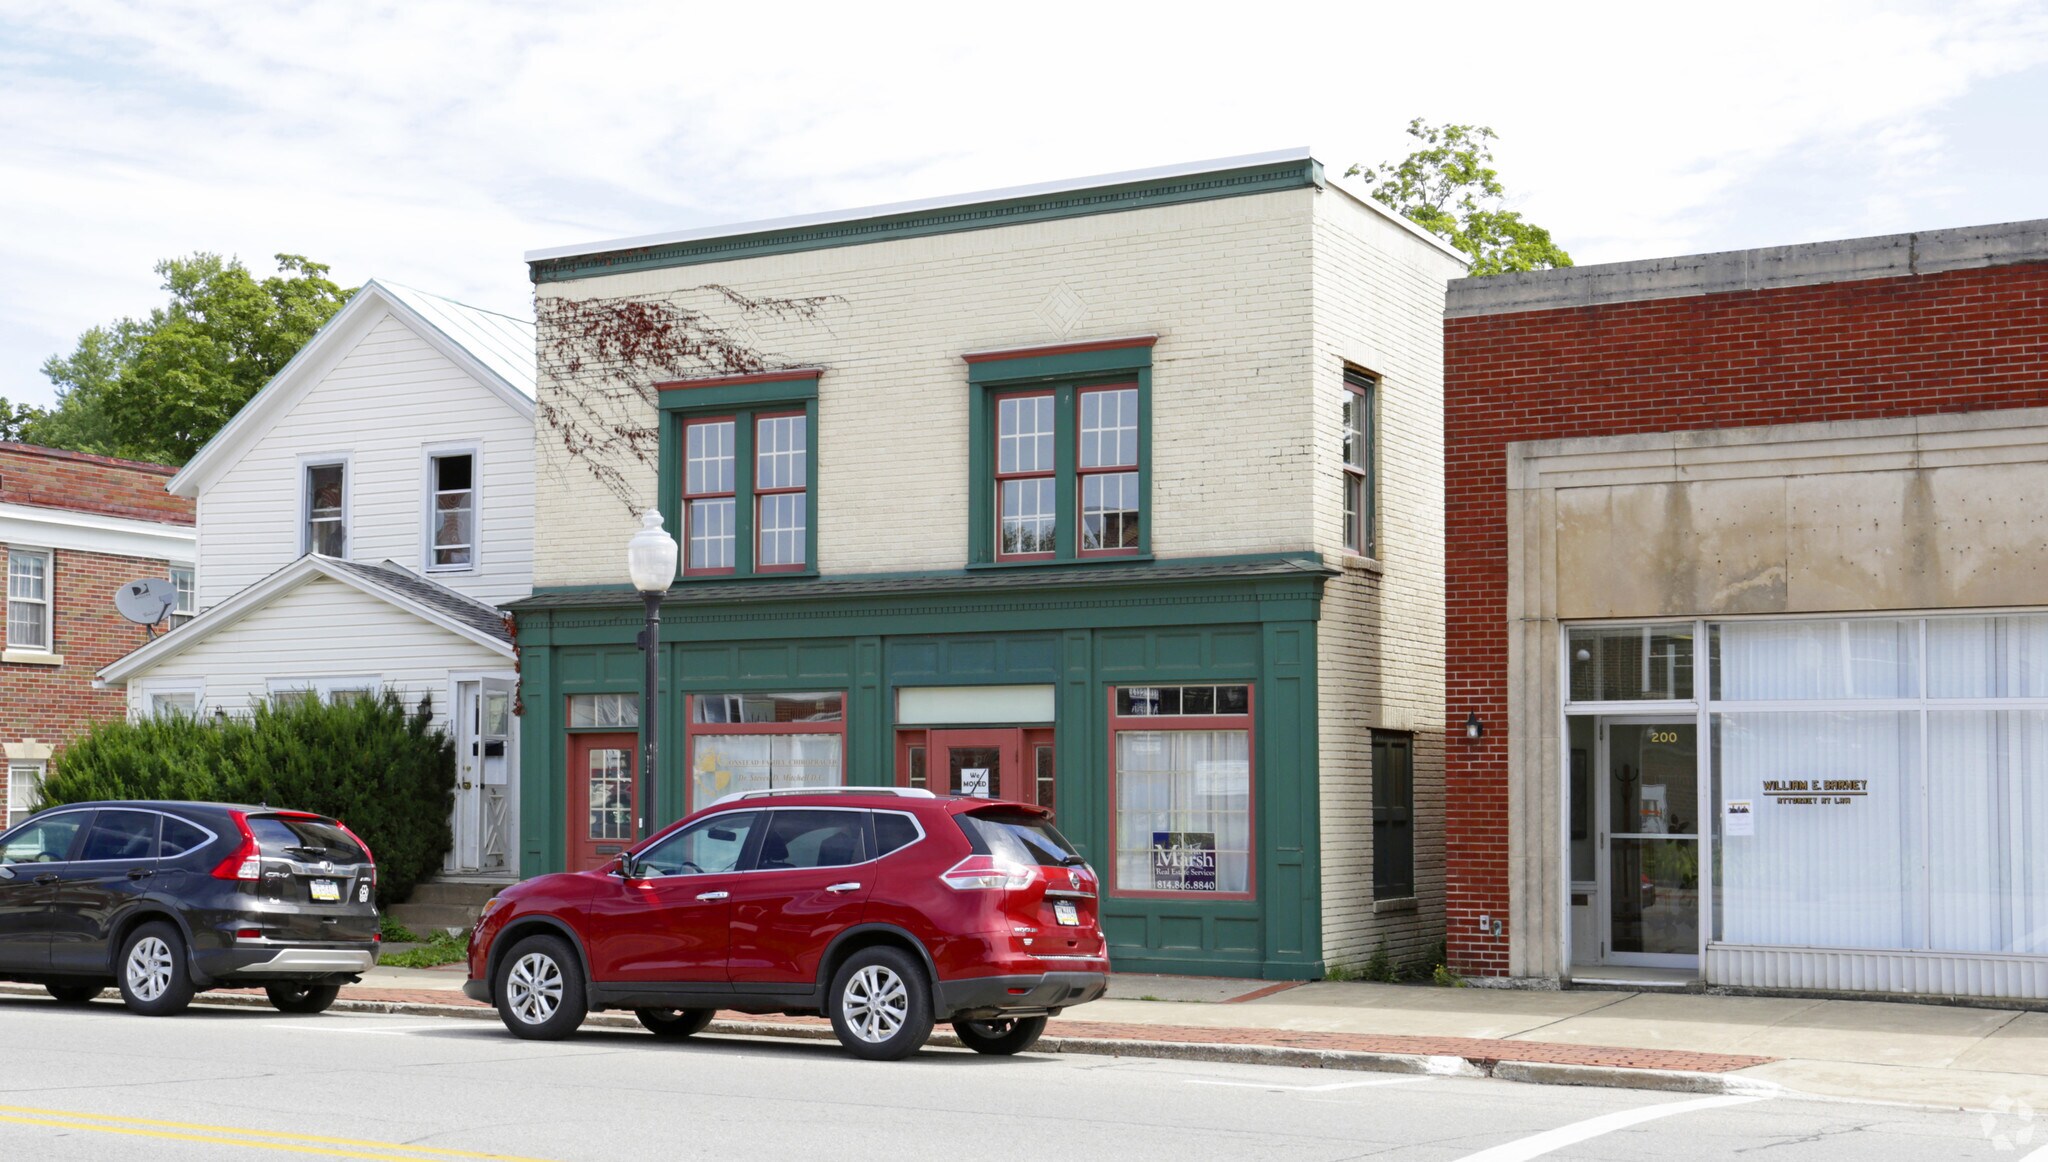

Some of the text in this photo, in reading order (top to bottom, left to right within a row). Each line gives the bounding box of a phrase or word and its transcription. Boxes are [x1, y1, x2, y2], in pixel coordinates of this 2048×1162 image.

[1651, 732, 1677, 742] 200
[1763, 780, 1808, 791] WILLIAM
[1811, 780, 1822, 791] E.
[1155, 844, 1214, 867] Marsh
[1156, 867, 1170, 876] Real
[1190, 868, 1215, 877] Services
[1156, 880, 1215, 890] 814.866.8840
